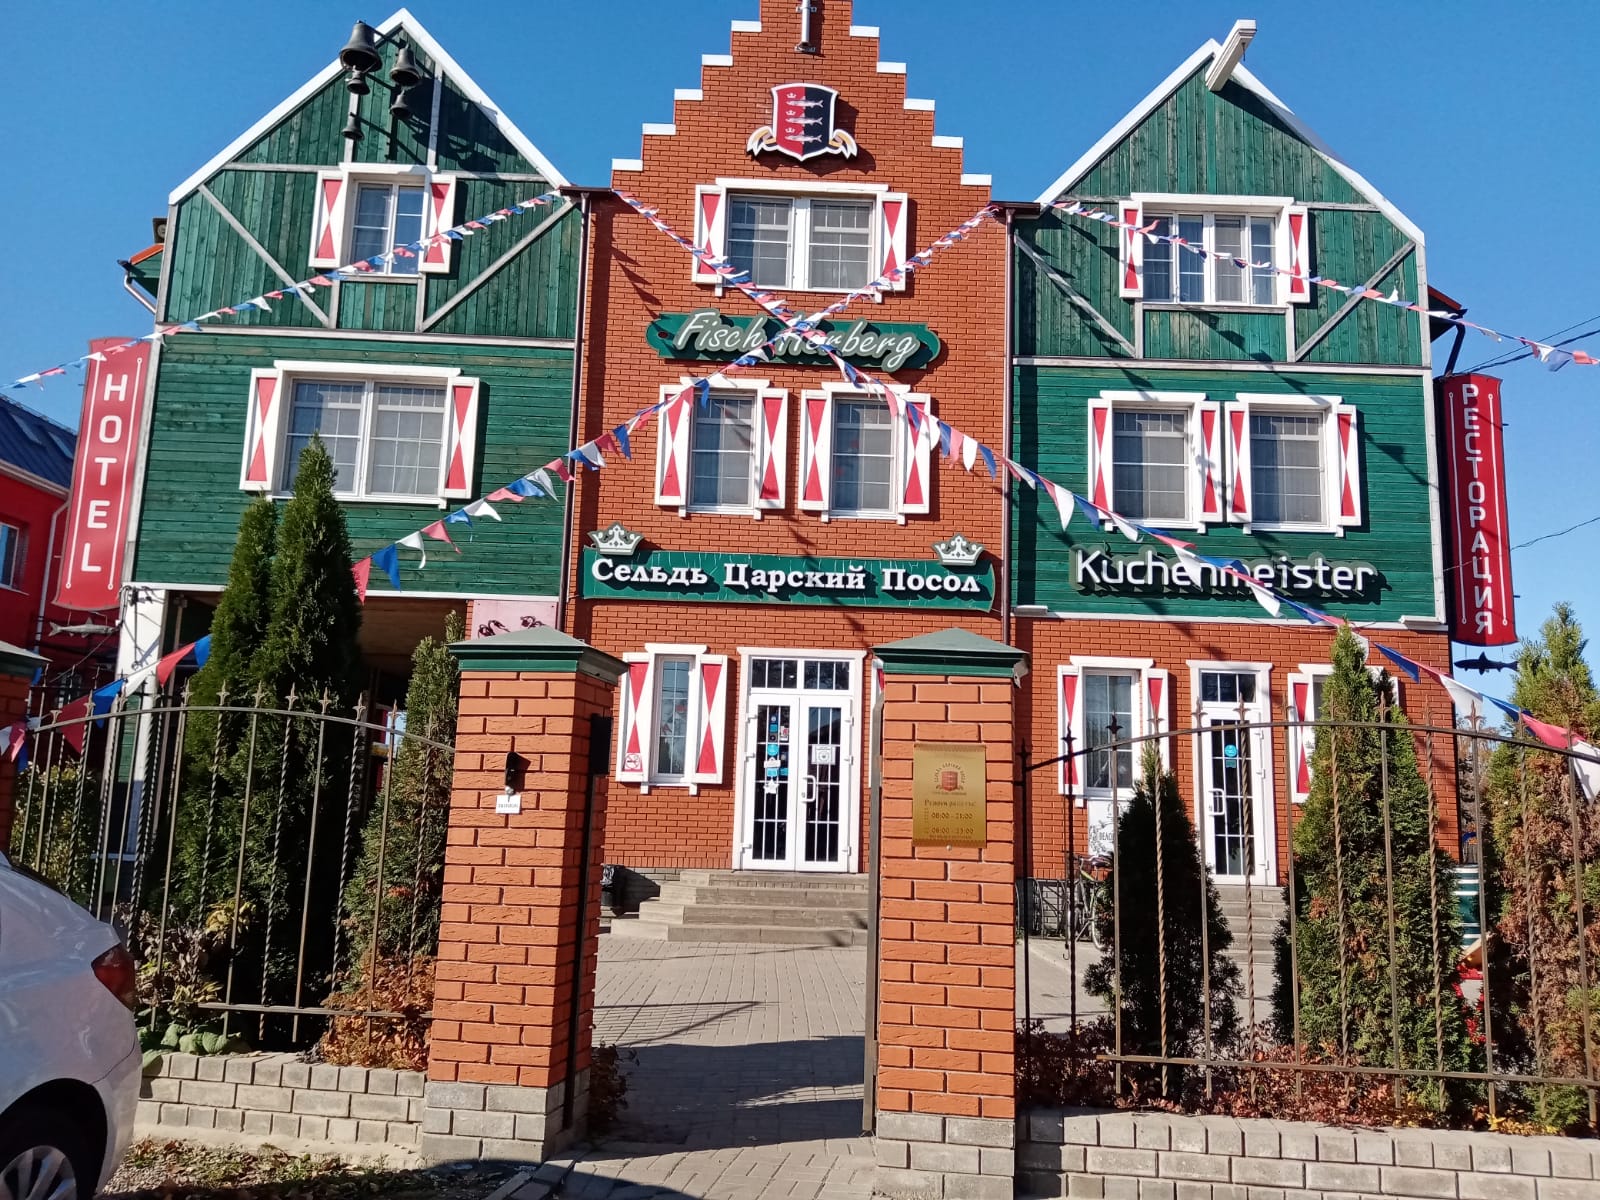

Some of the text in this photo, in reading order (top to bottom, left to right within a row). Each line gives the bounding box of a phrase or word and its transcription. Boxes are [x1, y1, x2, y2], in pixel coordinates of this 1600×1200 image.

[677, 310, 766, 349] Fisch
[80, 373, 129, 573] HOTEL
[1461, 382, 1494, 636] РЕСТОРАЦИЯ
[590, 557, 981, 594] Сельдь Царский Посол
